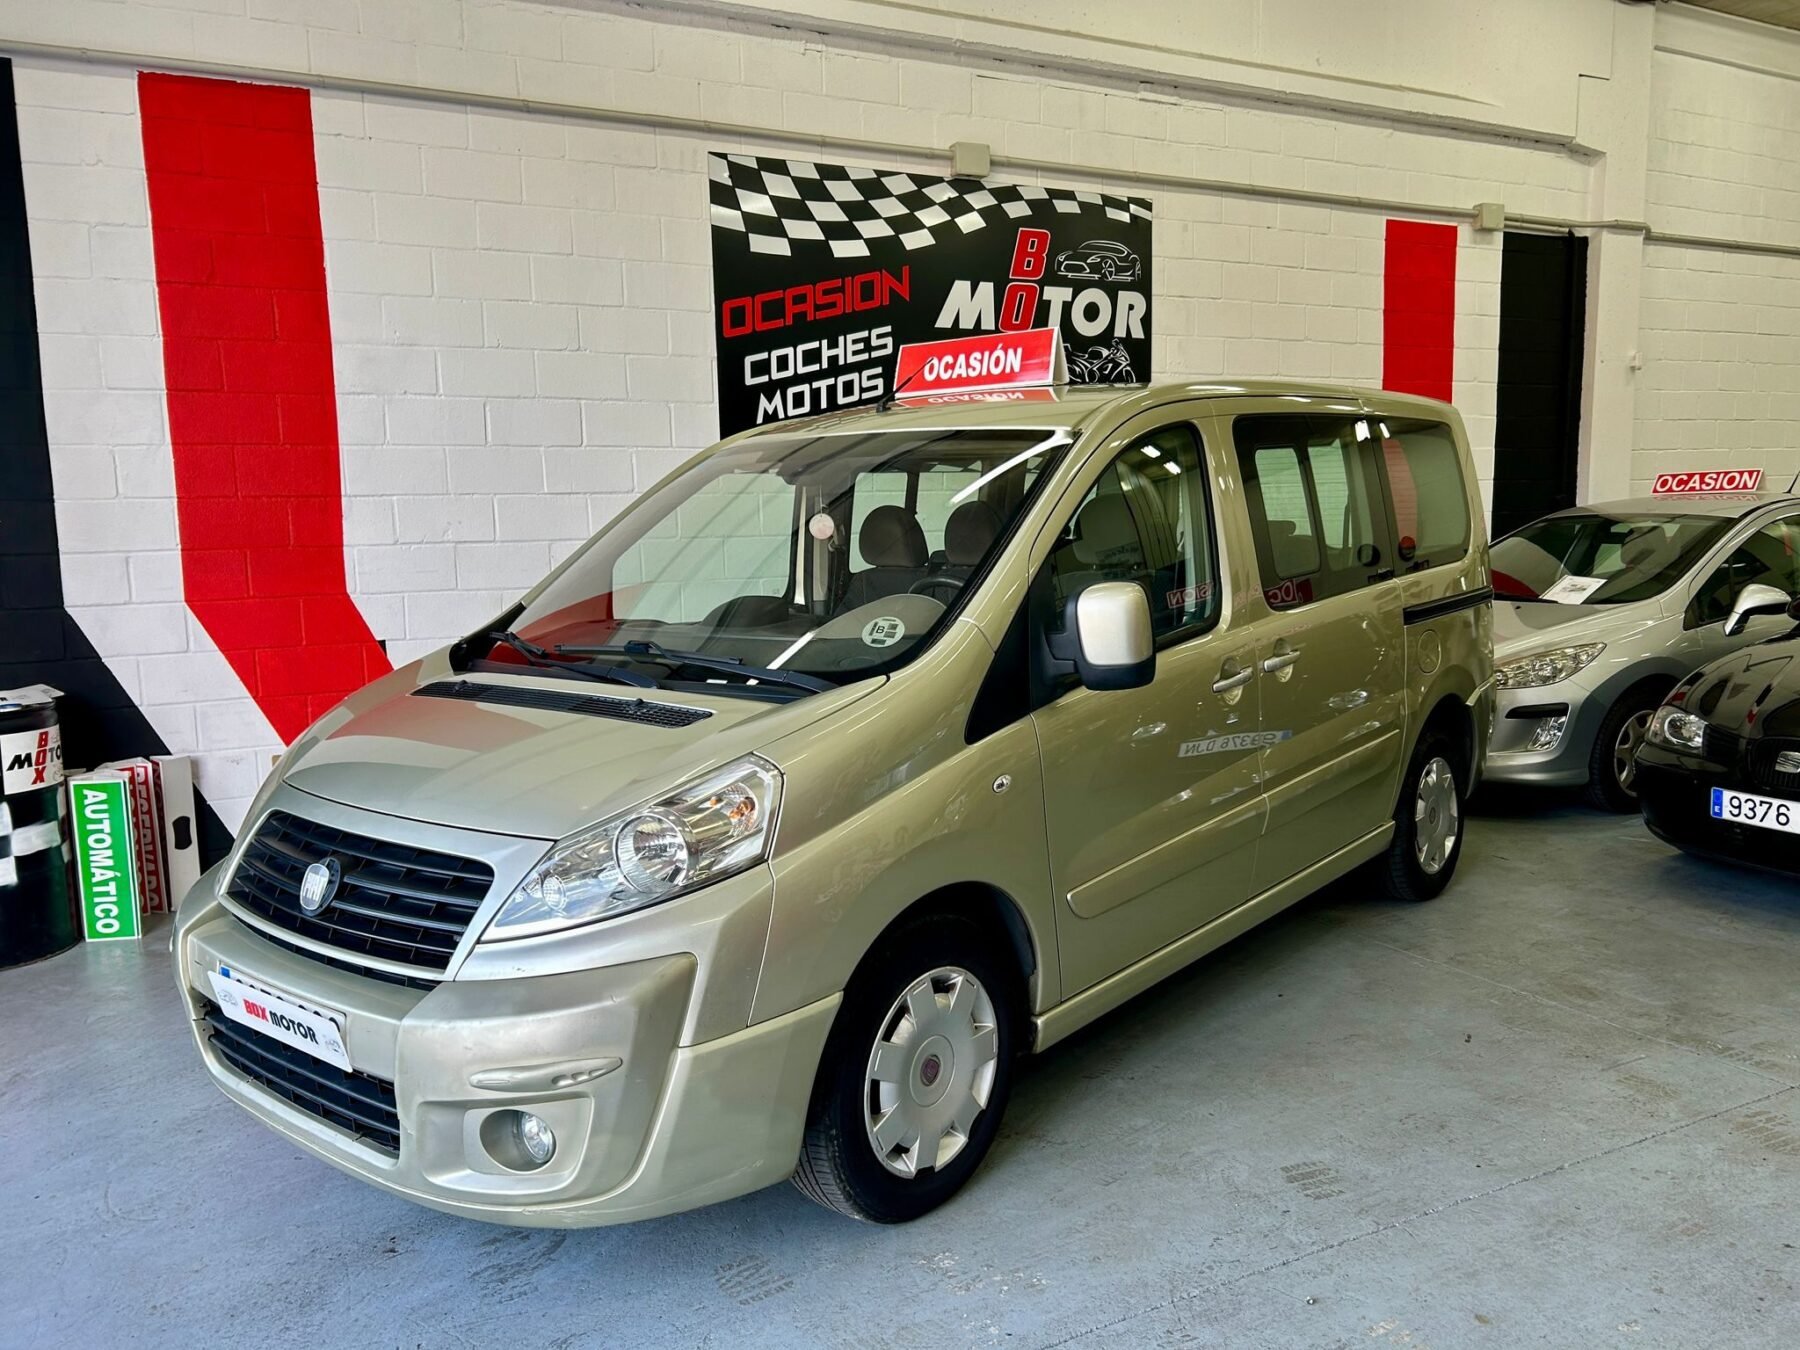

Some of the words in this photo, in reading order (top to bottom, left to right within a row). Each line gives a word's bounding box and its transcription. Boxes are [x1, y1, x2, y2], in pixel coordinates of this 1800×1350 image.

[721, 265, 911, 338] OCASION
[934, 279, 1147, 339] MOTOR
[743, 325, 893, 386] COCHES
[923, 343, 1023, 382] OCASIÓN
[756, 366, 885, 425] MOTOS
[1655, 471, 1758, 492] OCASION
[31, 730, 49, 785] BOX
[1729, 795, 1790, 826] 9376
[82, 788, 122, 935] AUTOMÁTICO
[243, 998, 269, 1023] BOX
[268, 1010, 319, 1045] MOTOR
